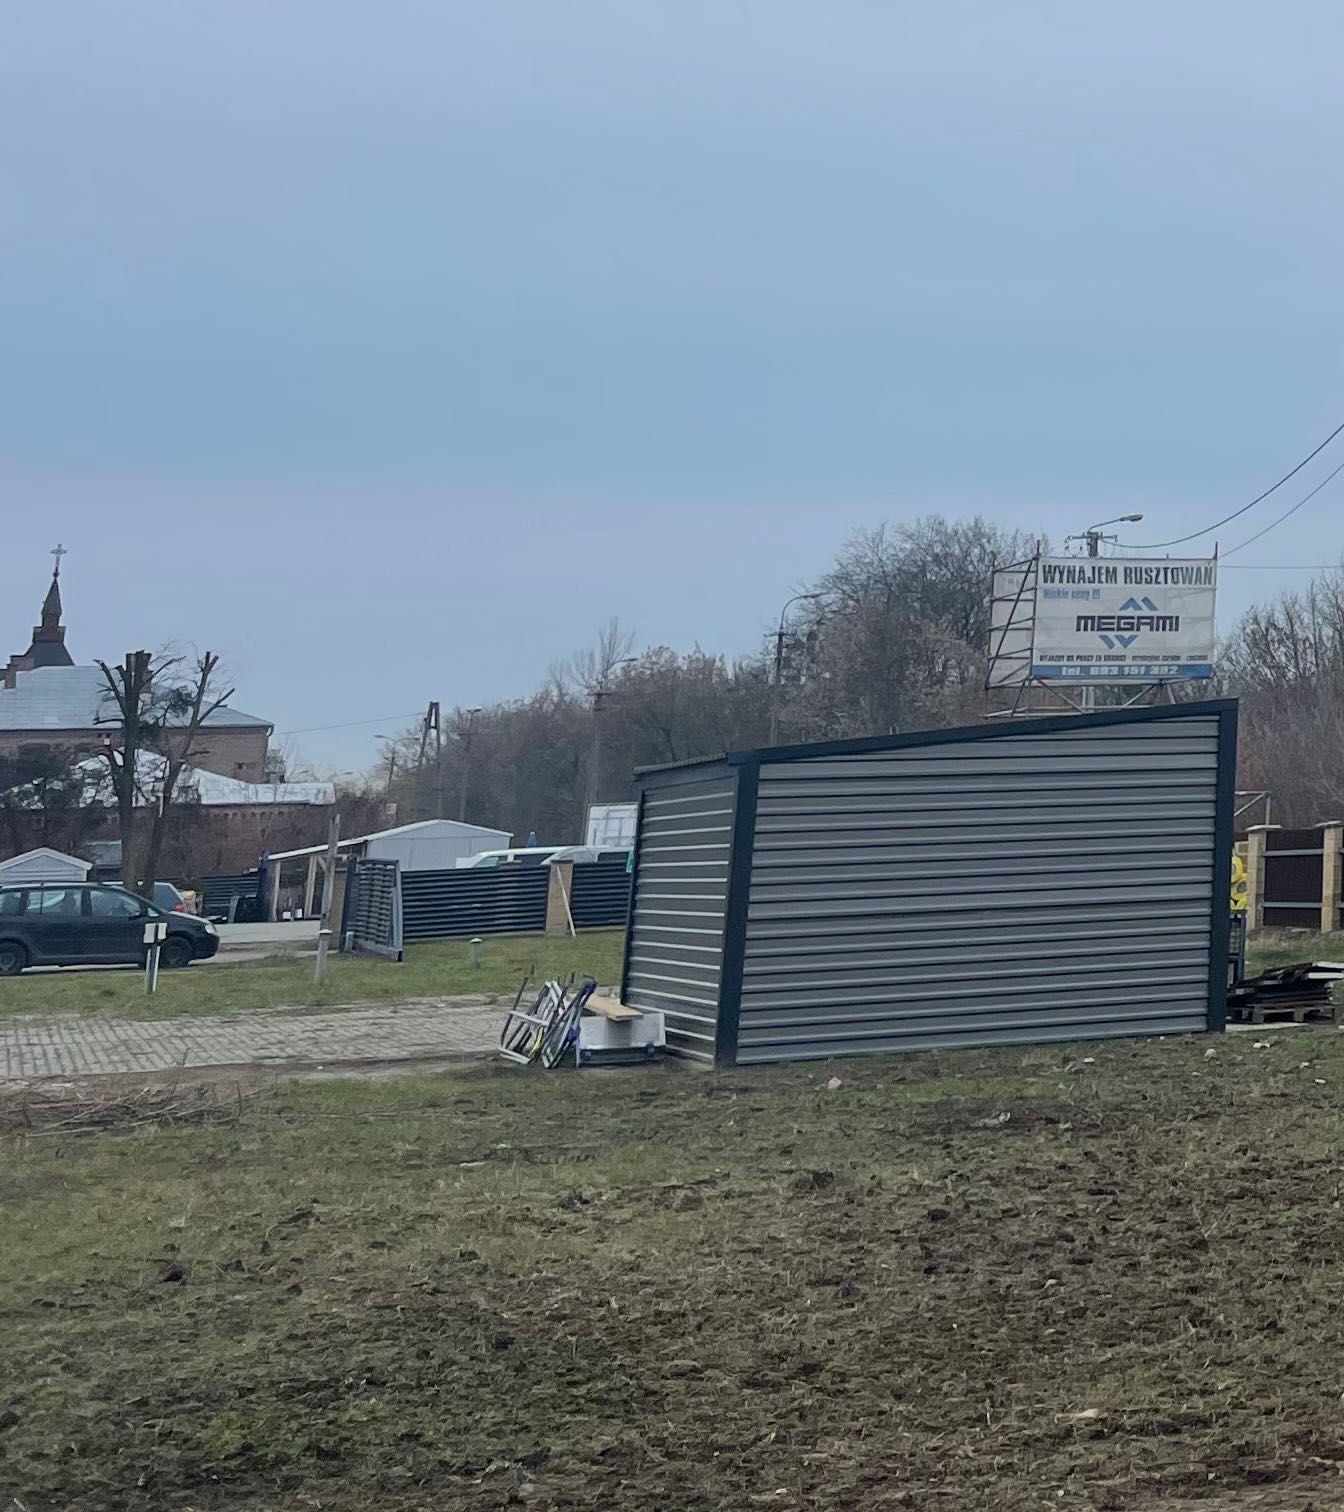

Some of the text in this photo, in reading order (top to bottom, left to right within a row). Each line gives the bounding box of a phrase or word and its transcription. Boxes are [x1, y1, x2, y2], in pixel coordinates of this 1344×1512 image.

[1042, 563, 1213, 586] WYNAJEM RUSZTOWAŃ
[1075, 615, 1180, 632] MEGAMI
